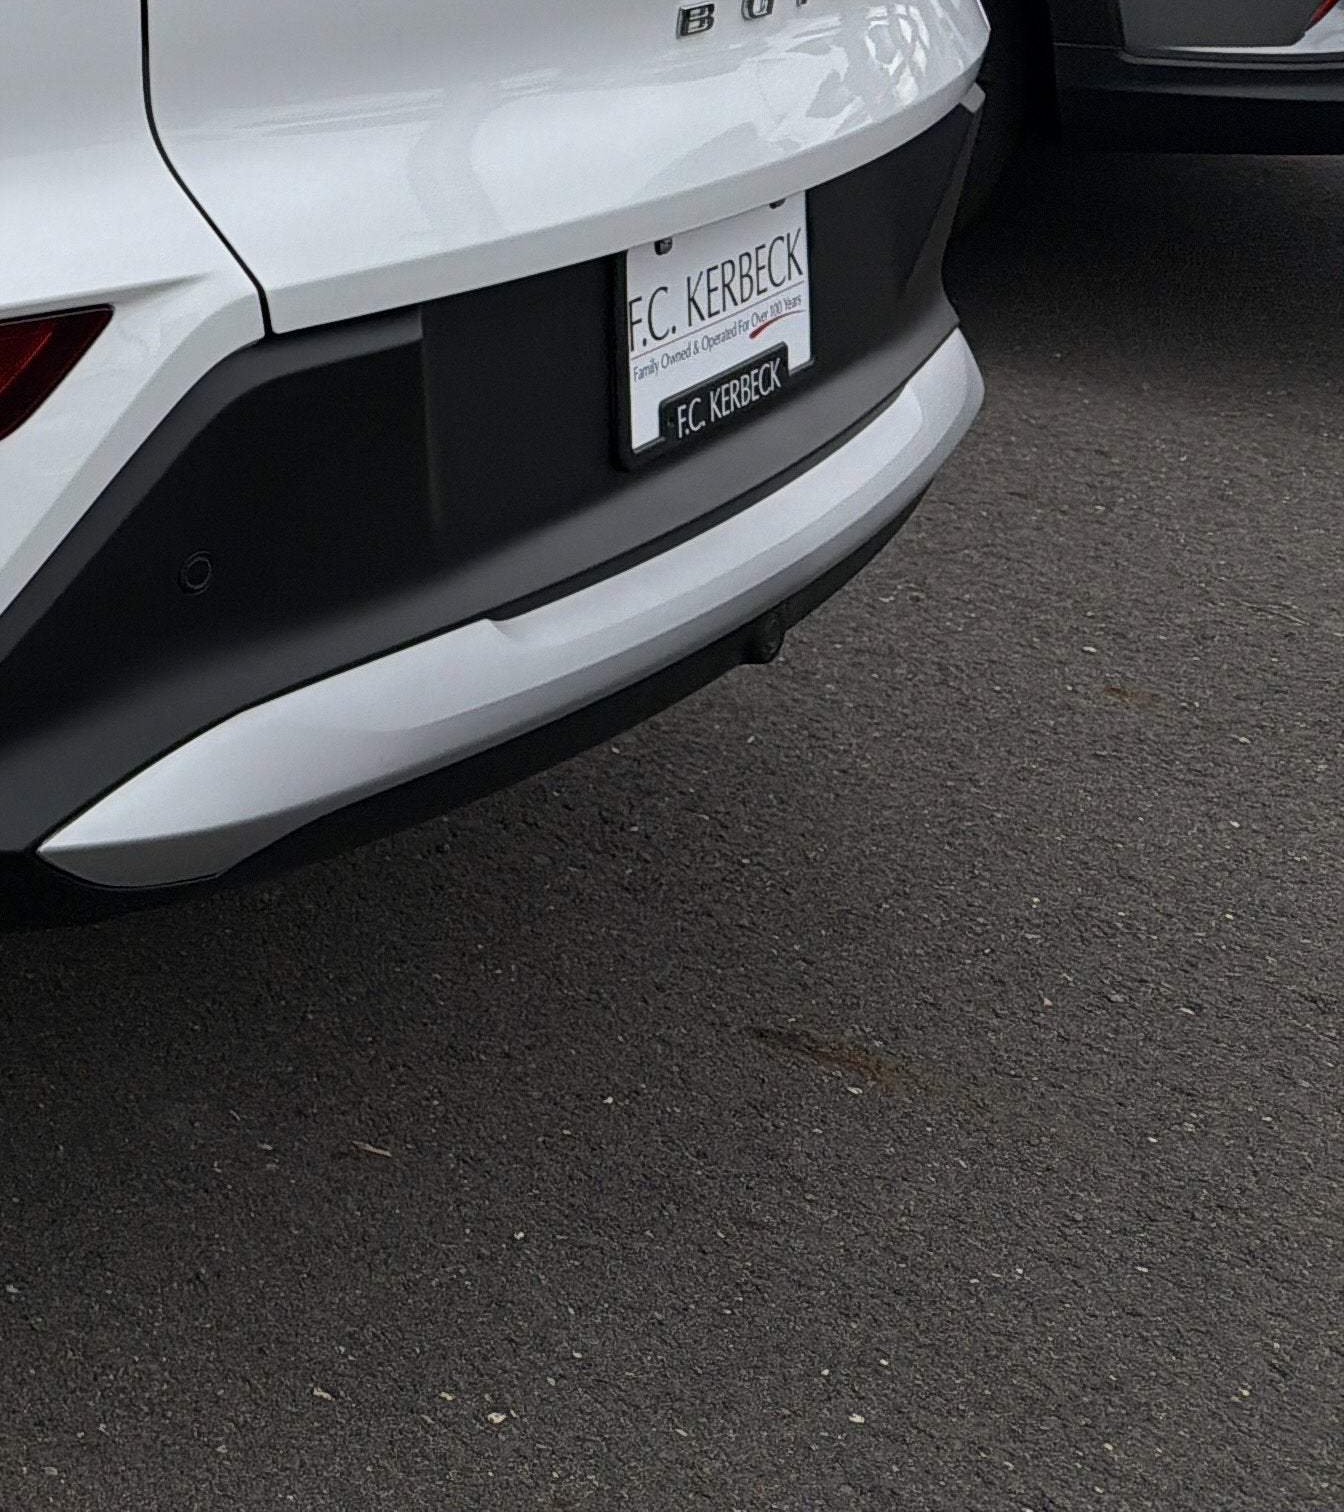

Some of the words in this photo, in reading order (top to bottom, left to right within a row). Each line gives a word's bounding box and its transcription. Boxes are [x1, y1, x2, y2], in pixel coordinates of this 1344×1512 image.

[628, 286, 677, 352] F.C.
[686, 227, 803, 328] KERBECK
[633, 359, 660, 383] Family
[661, 344, 692, 369] Owned
[693, 343, 700, 356] &
[701, 326, 737, 352] Operated
[738, 318, 750, 335] For
[751, 310, 768, 328] Over
[769, 303, 782, 318] 100
[783, 294, 802, 311] Years
[677, 397, 706, 438] F.C.
[709, 357, 782, 422] KERBECK
